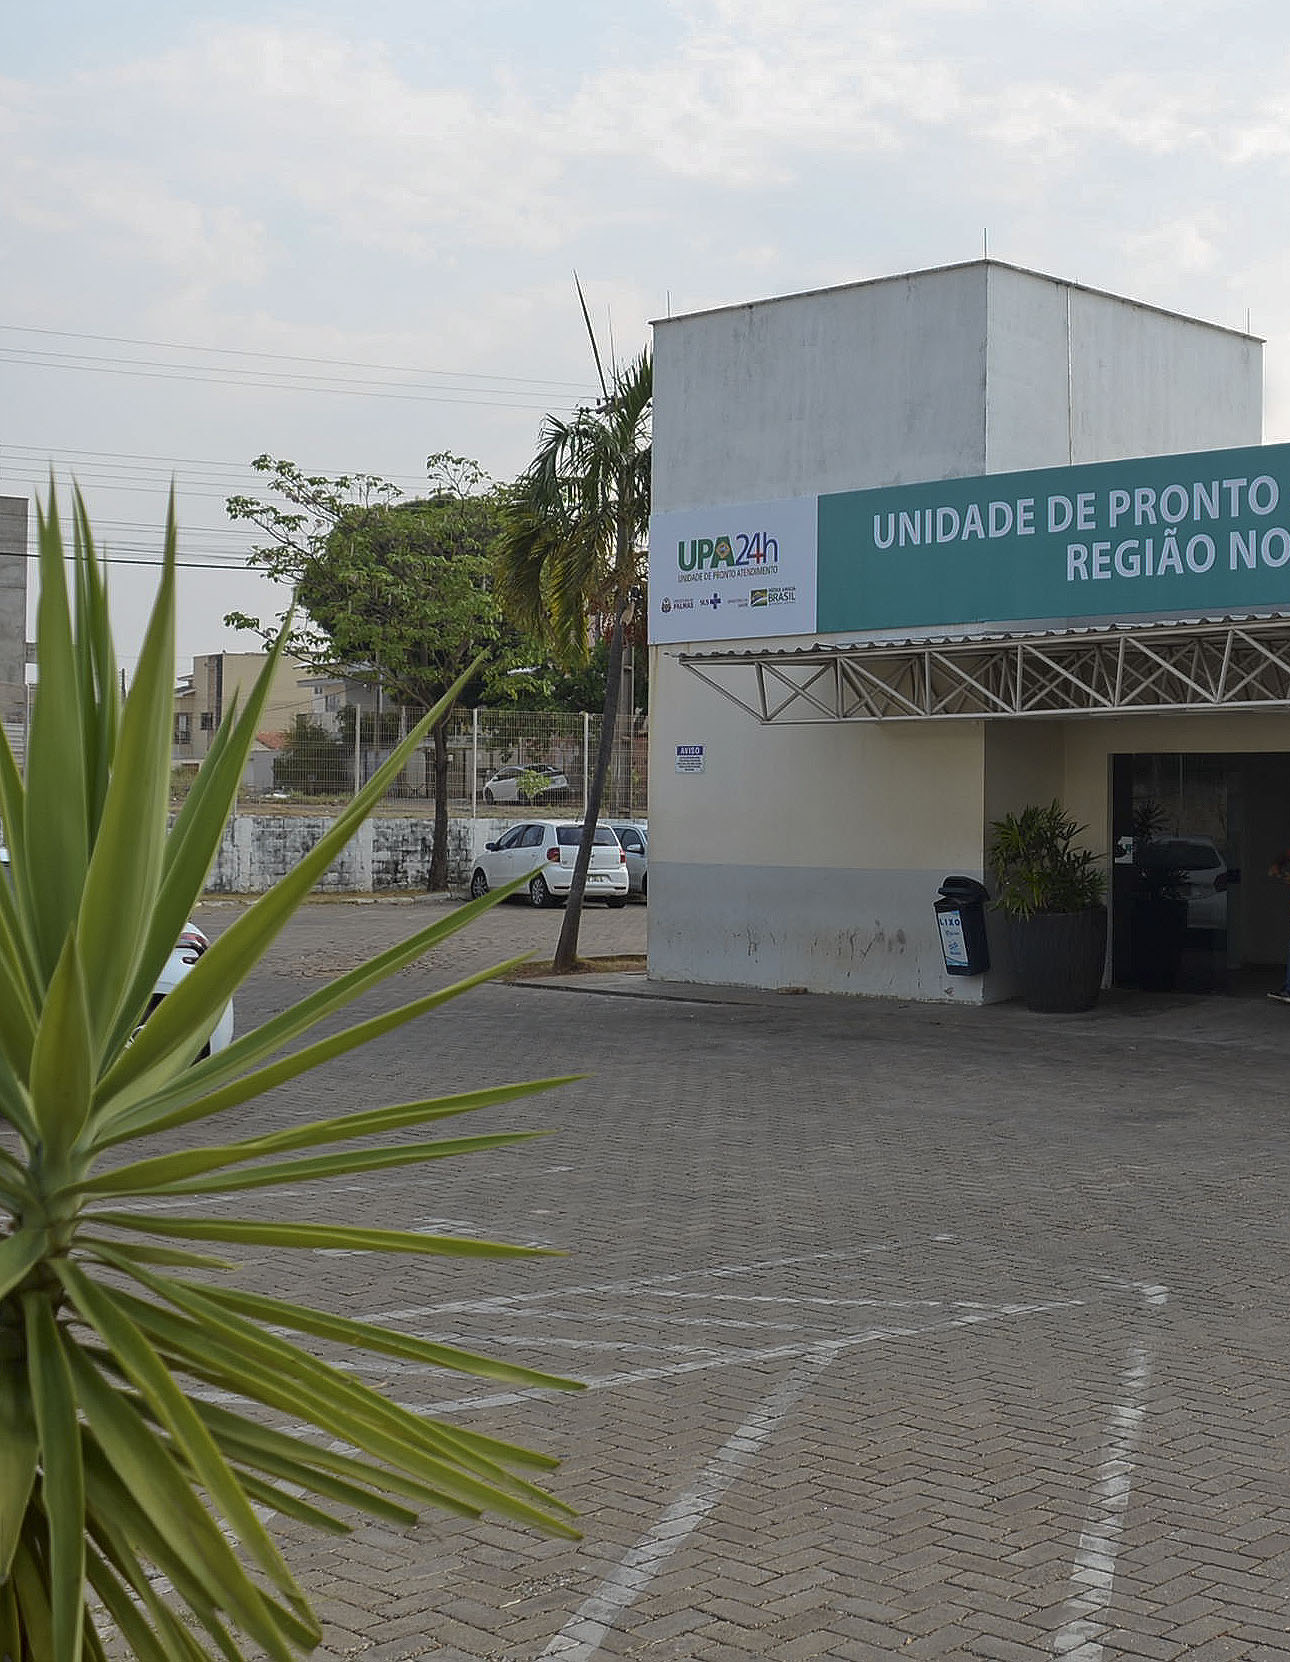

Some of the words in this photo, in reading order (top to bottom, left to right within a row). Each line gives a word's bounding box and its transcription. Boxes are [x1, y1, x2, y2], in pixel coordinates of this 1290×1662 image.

[873, 499, 1035, 549] UNIDADE
[1047, 492, 1097, 533] DE
[1109, 474, 1280, 528] PRONTO
[1066, 528, 1216, 581] REGIÃO
[768, 592, 796, 602] BRASIL
[940, 918, 960, 926] LIXO
